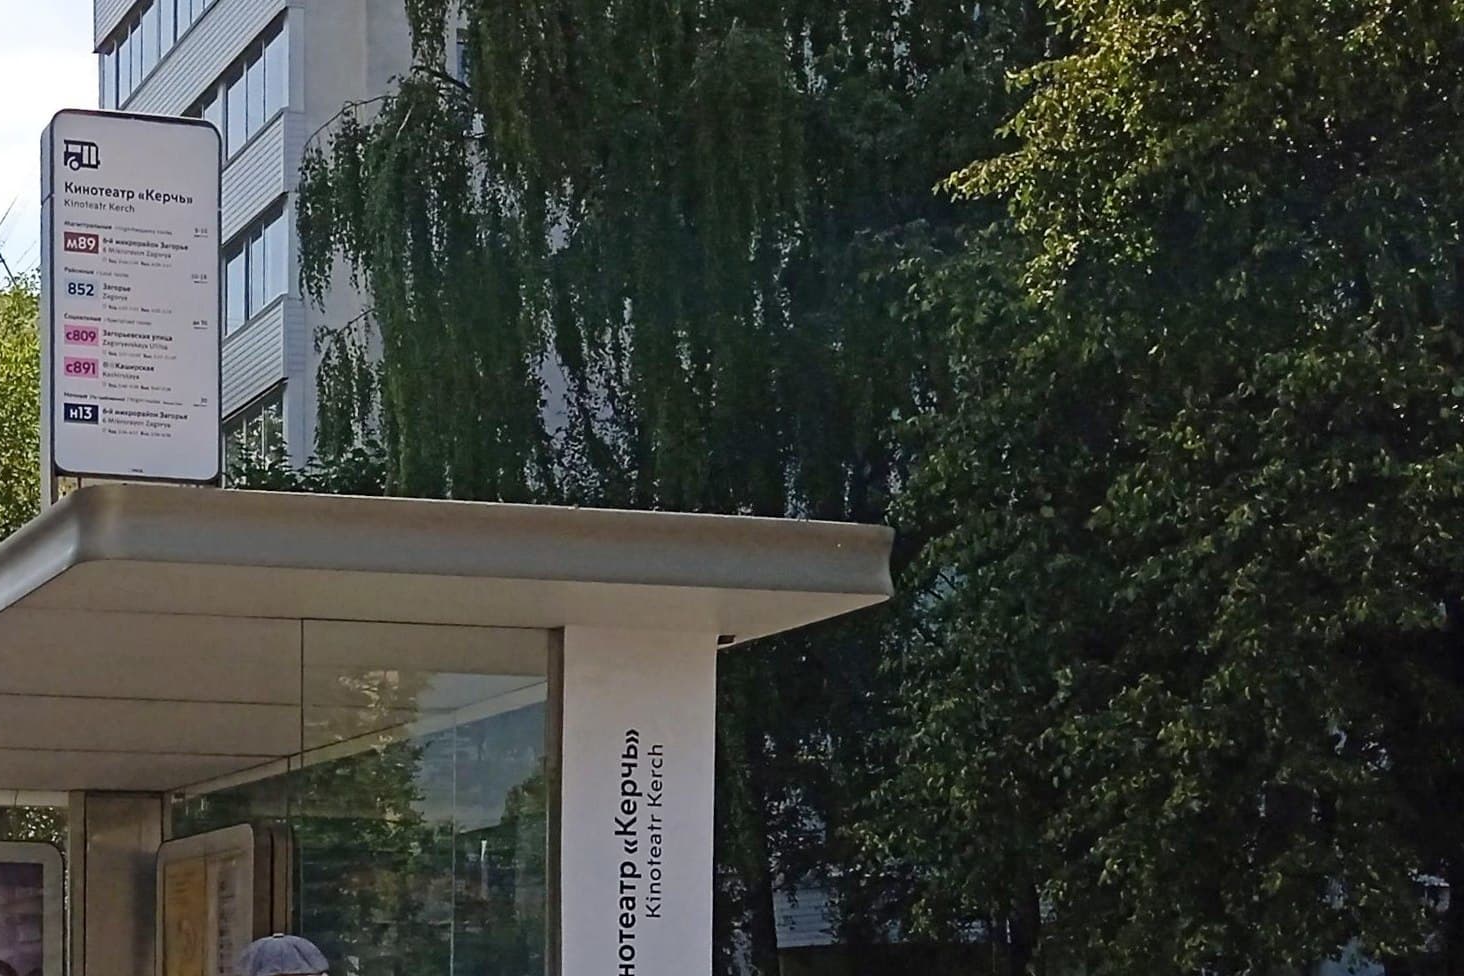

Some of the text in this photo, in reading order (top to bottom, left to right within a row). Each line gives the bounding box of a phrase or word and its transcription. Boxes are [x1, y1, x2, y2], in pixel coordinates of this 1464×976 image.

[64, 181, 193, 204] Кинотеатр «Керчь»
[64, 199, 135, 213] Kinoteatr Kerch
[67, 282, 95, 296] 852
[65, 329, 97, 342] с809
[65, 361, 96, 375] с891
[69, 406, 93, 420] н13
[614, 728, 643, 855] «Керчь»
[645, 743, 664, 919] Kinoteatr Kerch
